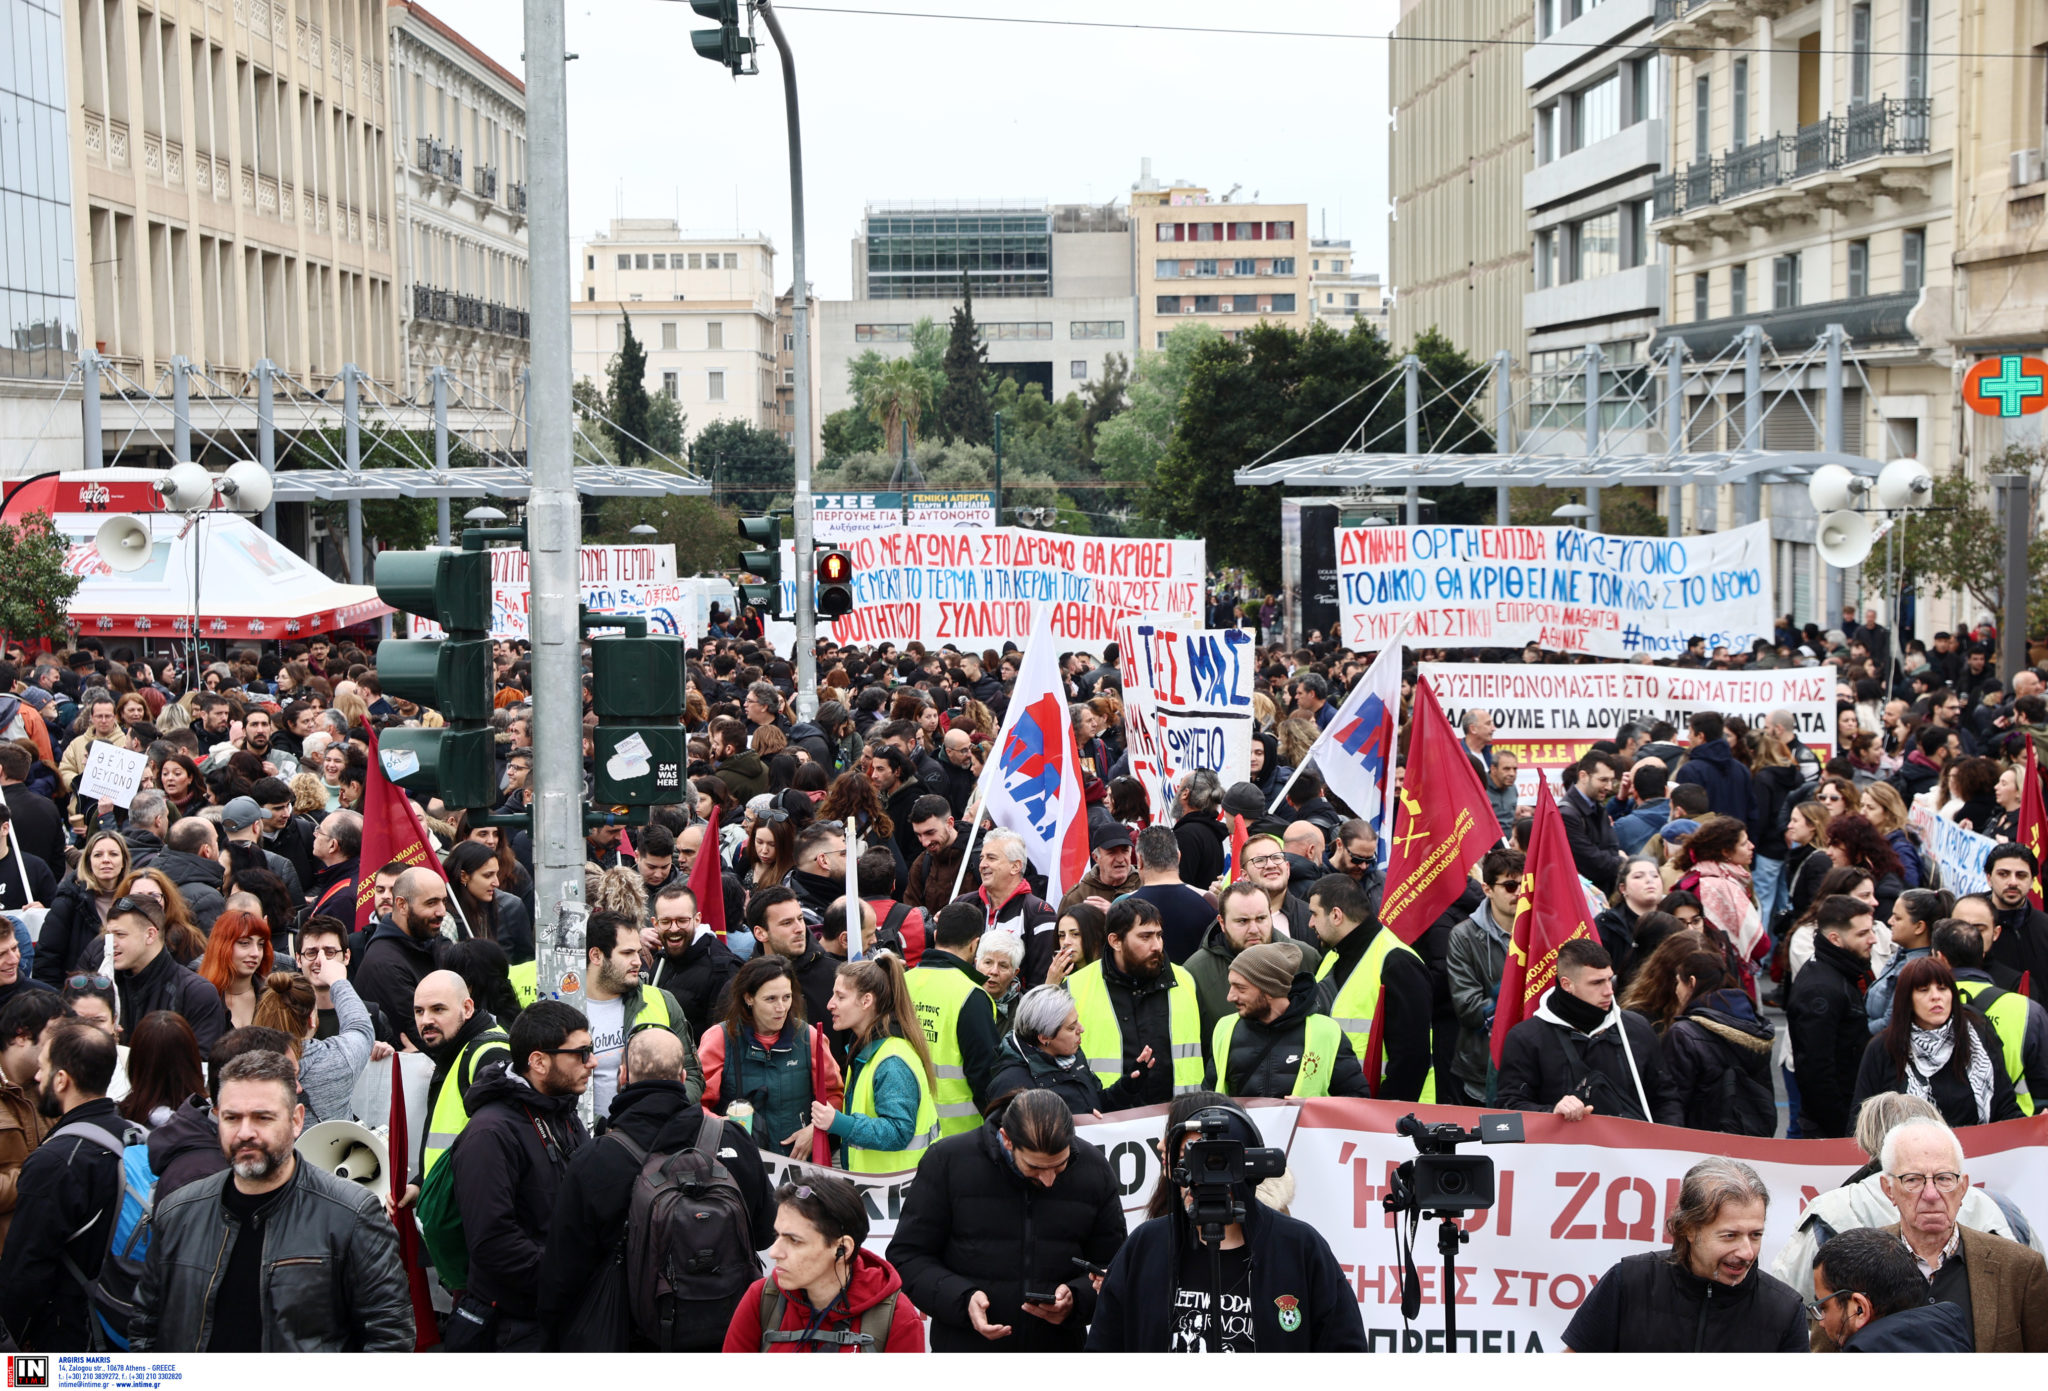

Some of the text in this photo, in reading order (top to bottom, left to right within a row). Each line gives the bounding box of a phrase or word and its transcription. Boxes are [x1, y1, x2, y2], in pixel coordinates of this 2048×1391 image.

[913, 494, 990, 502] ΓΕΝΙΚΗ ΑΠΕΡΓΙΑ
[812, 511, 876, 522] ΠΕΡΓΟΥΜΕ
[879, 511, 897, 521] ΓΙΑ
[919, 511, 990, 521] ΑΥΤΟΝΟΗΤΟ
[1412, 528, 1480, 559] ΟΡΓΗ
[613, 548, 655, 580] ΤΕΜΠΗ
[905, 534, 974, 566] ΑΓΩΝΑ
[980, 534, 1011, 566] ΣΤΟ
[1013, 536, 1075, 571] ΔΡΟΜΟ
[1083, 542, 1106, 576] ΘΑ
[1110, 542, 1173, 578] ΚΡΙΘΕΙ
[904, 568, 923, 599] ΤΟ
[927, 569, 976, 600] ΤΕΡΜΑ
[1014, 570, 1058, 601] ΚΕΡΔΗ
[1436, 566, 1463, 600] ΘΑ
[1470, 566, 1547, 600] ΚΡΙΘΕΙ
[1551, 568, 1583, 602] ΜΕ
[1662, 575, 1706, 609] ΣΤΟ
[1712, 568, 1761, 602] ΔΡΟΜΟ
[937, 601, 1031, 638] ΣΥΛΛΟΓΟΙ
[1434, 673, 1827, 703] ΣΥΣΠΕΙΡΩΝΟΜΑΣΤΕ ΣΤΟ ΣΩΜΑΤΕΙΟ ΜΑΣ
[1551, 708, 1581, 729] ΓΙΑ
[97, 752, 136, 773] ΘΕΛΩ
[659, 763, 677, 771] SAM
[91, 766, 133, 790] ΟΞΥΓΟΝΟ
[657, 779, 678, 787] HERE
[658, 771, 677, 779] WAS
